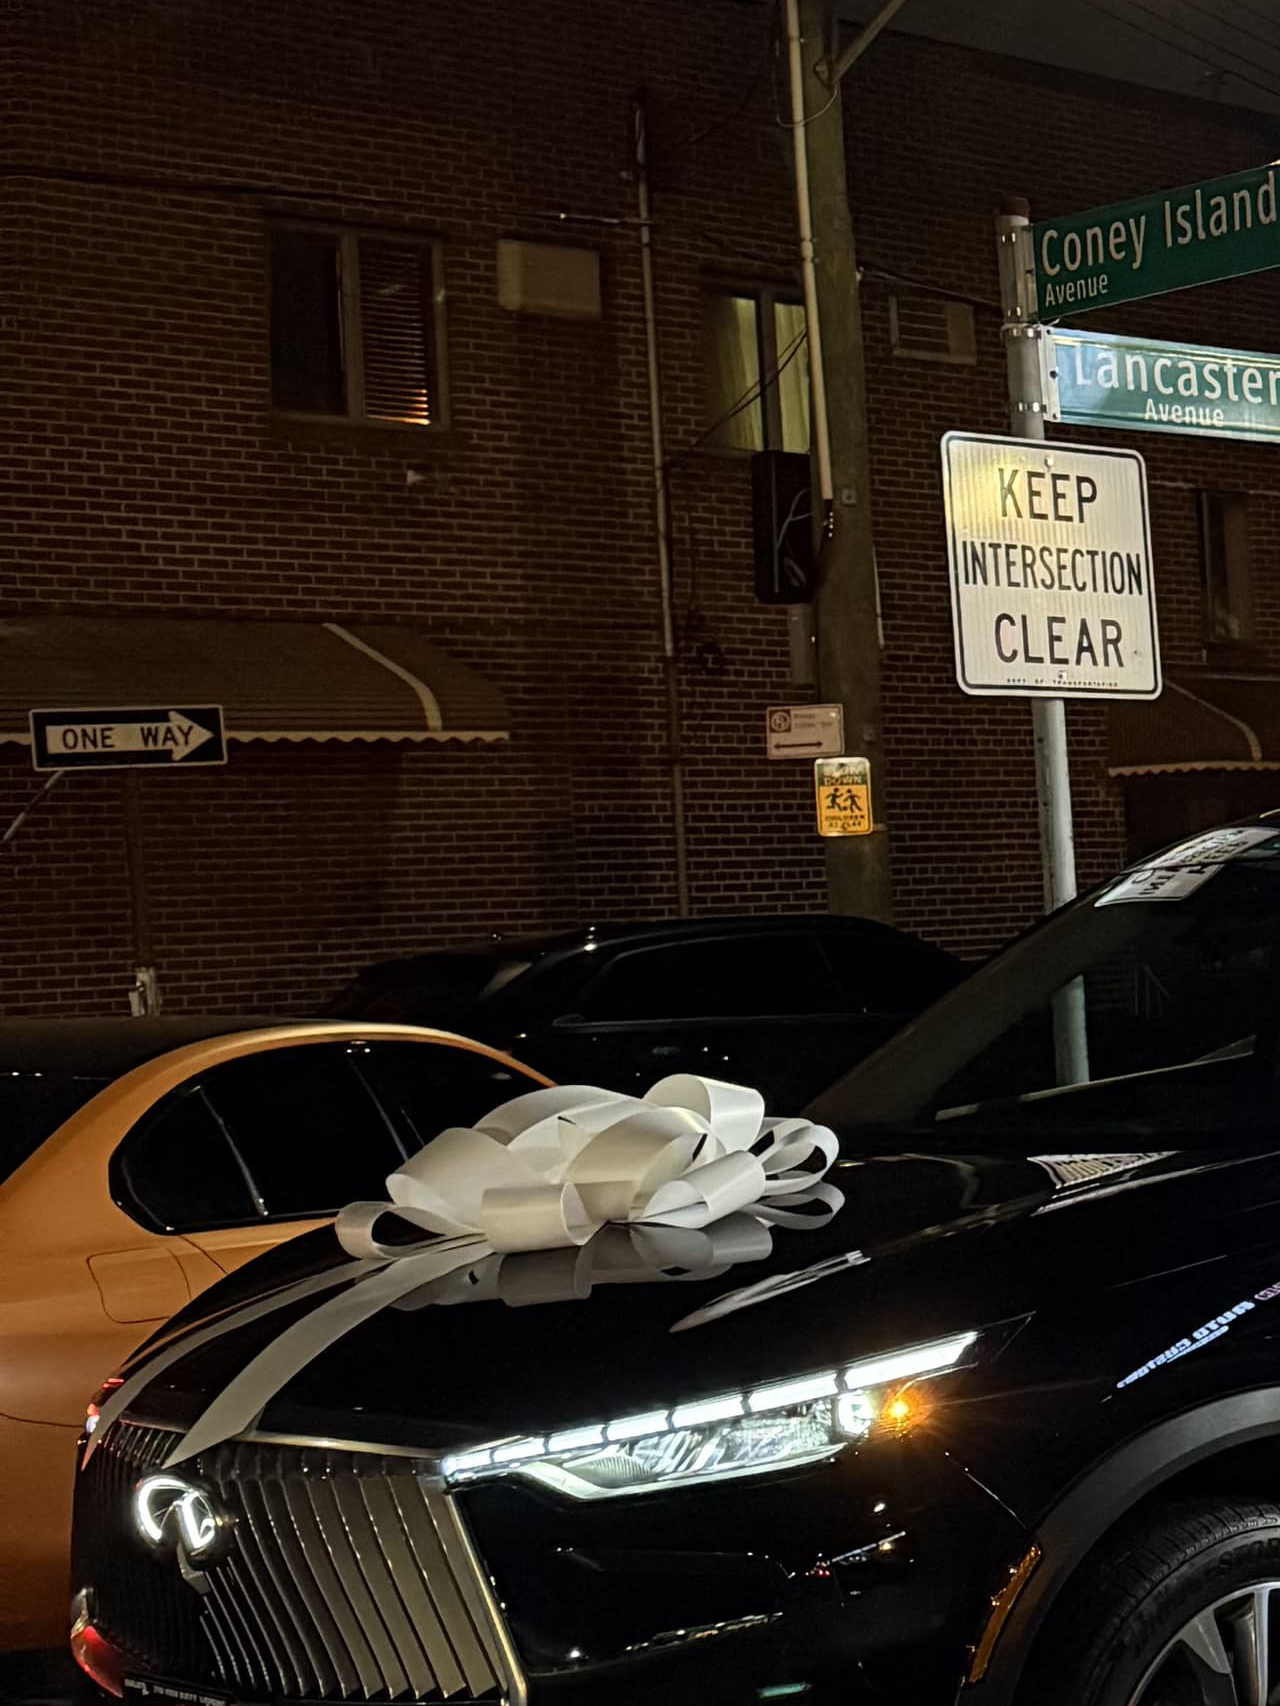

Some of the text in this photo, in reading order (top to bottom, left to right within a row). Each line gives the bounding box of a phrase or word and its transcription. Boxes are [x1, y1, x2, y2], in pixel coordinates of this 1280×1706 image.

[1042, 170, 1278, 276] Coney Island
[1045, 274, 1109, 307] Avenue
[1144, 398, 1225, 428] Avenue
[997, 467, 1097, 524] KEEP
[961, 540, 1143, 596] INTERSECTION
[993, 612, 1125, 668] CLEAR
[62, 724, 193, 750] ONE WAY
